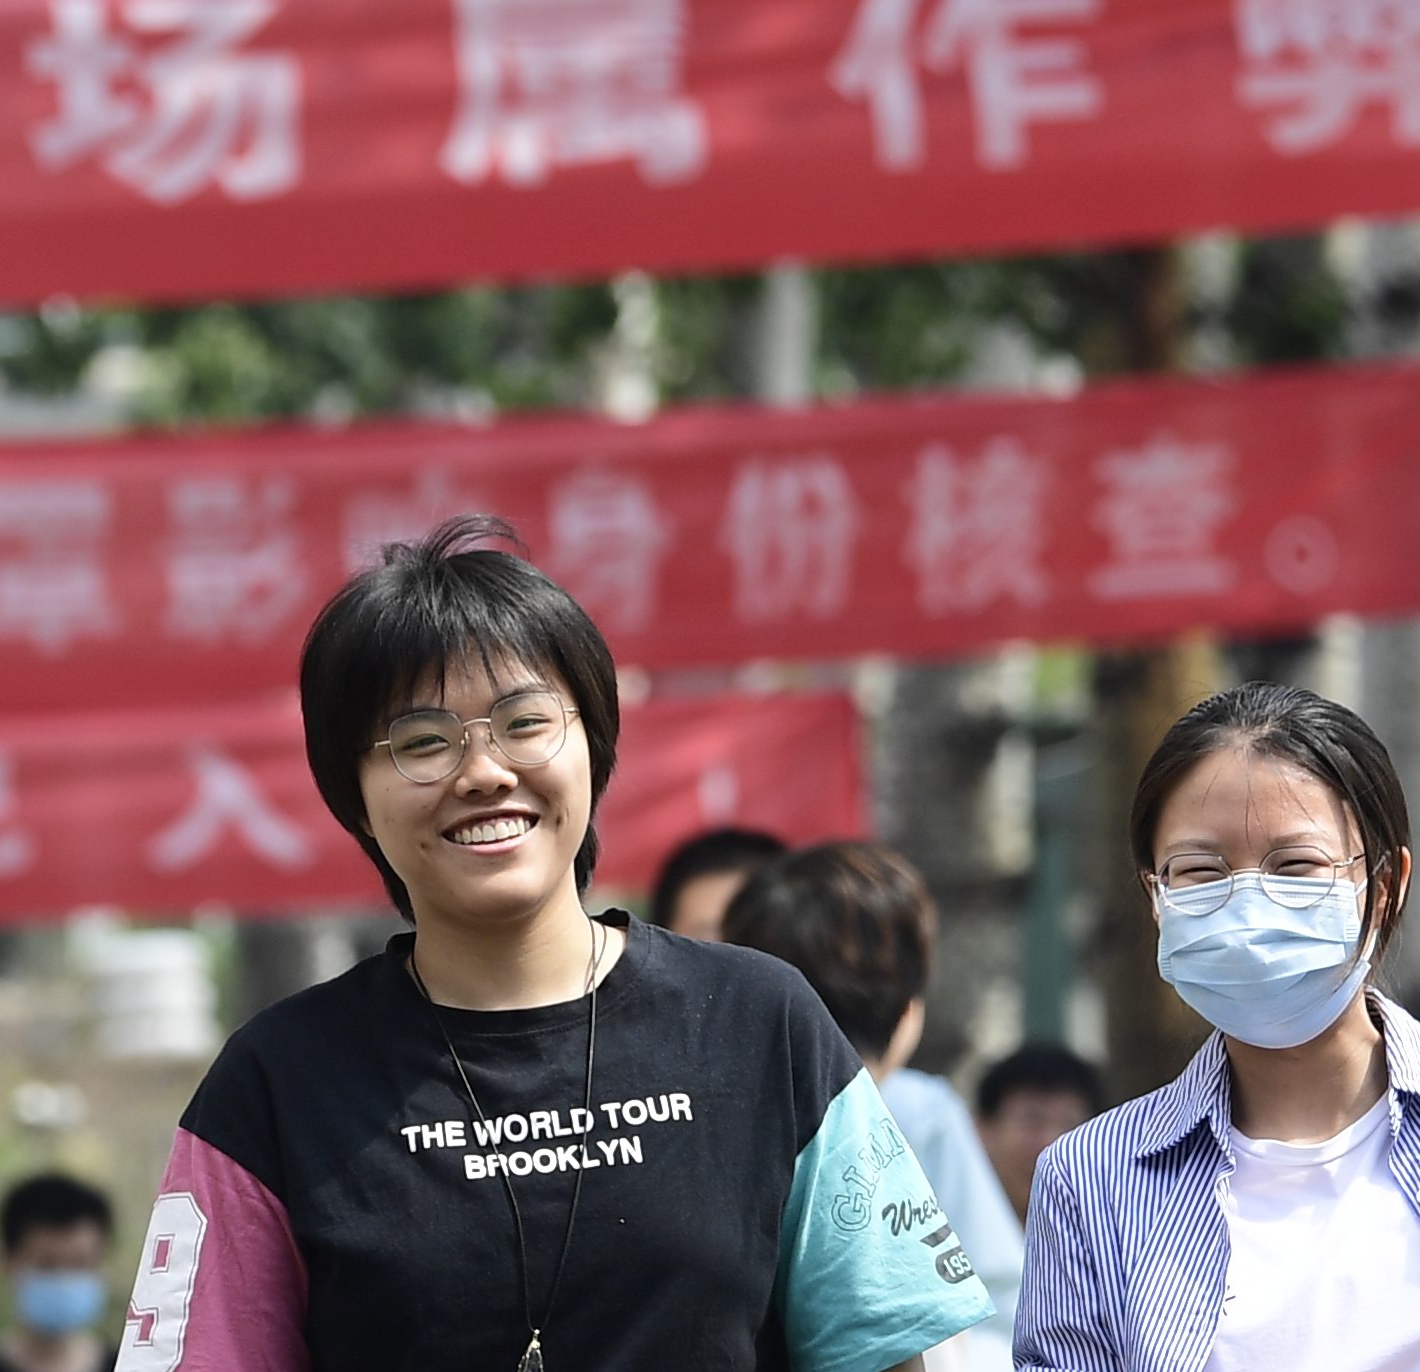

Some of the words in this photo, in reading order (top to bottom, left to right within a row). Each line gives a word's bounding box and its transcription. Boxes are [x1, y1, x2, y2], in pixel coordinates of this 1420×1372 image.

[401, 1120, 467, 1152] THE
[473, 1107, 594, 1147] WORLD
[600, 1092, 693, 1129] TOUR
[463, 1136, 644, 1180] BROOKLYN
